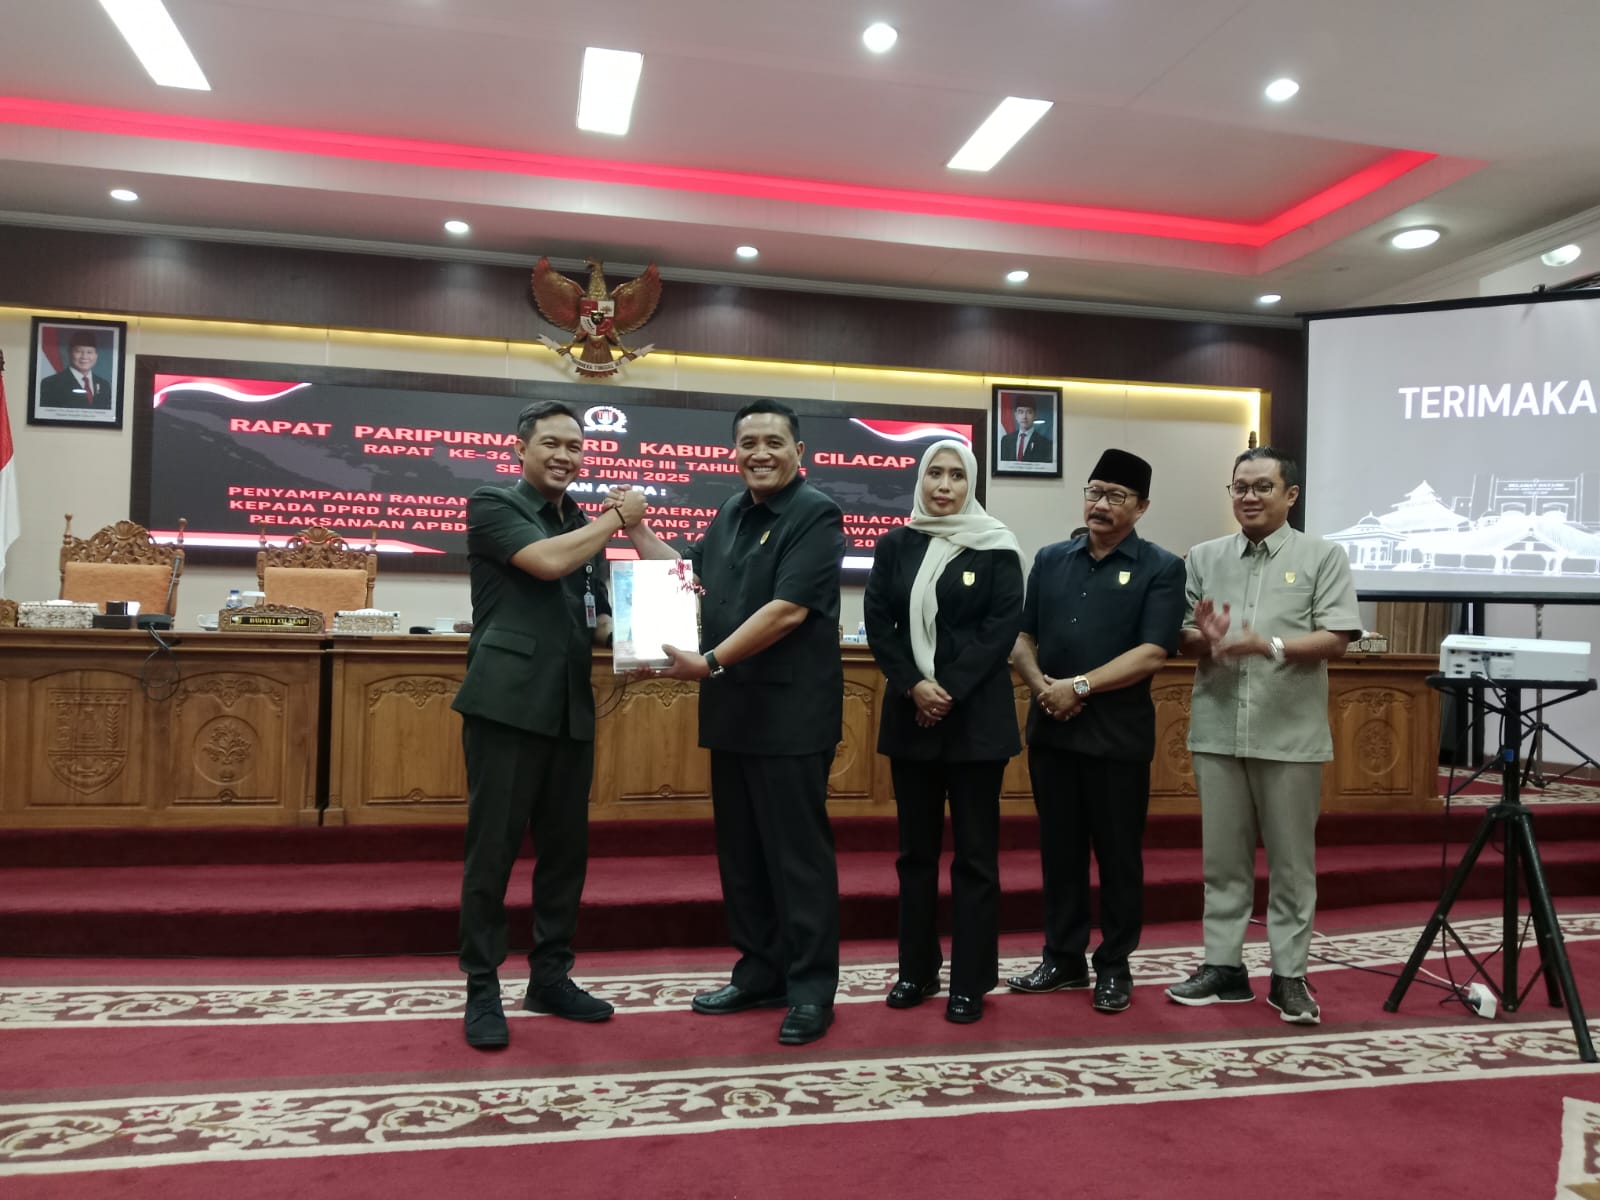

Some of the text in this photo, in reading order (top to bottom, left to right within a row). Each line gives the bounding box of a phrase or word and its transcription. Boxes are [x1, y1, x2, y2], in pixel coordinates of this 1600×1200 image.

[1398, 379, 1598, 420] TERIMAKA
[229, 418, 917, 469] RAPAT PARIPURNA RD KABUP CILACAP
[363, 444, 741, 474] RAPAT KE-36 SIDANG III TAHU
[594, 469, 639, 481] JUNI
[643, 472, 691, 483] 2025
[228, 487, 383, 503] PENYAMPAIAN
[389, 494, 469, 507] RANCAN
[229, 501, 317, 514] KEPADA
[323, 504, 381, 516] DPRD
[386, 508, 468, 520] KABUPA
[249, 514, 405, 530] PELAKSANAAN
[411, 521, 468, 532] APBD
